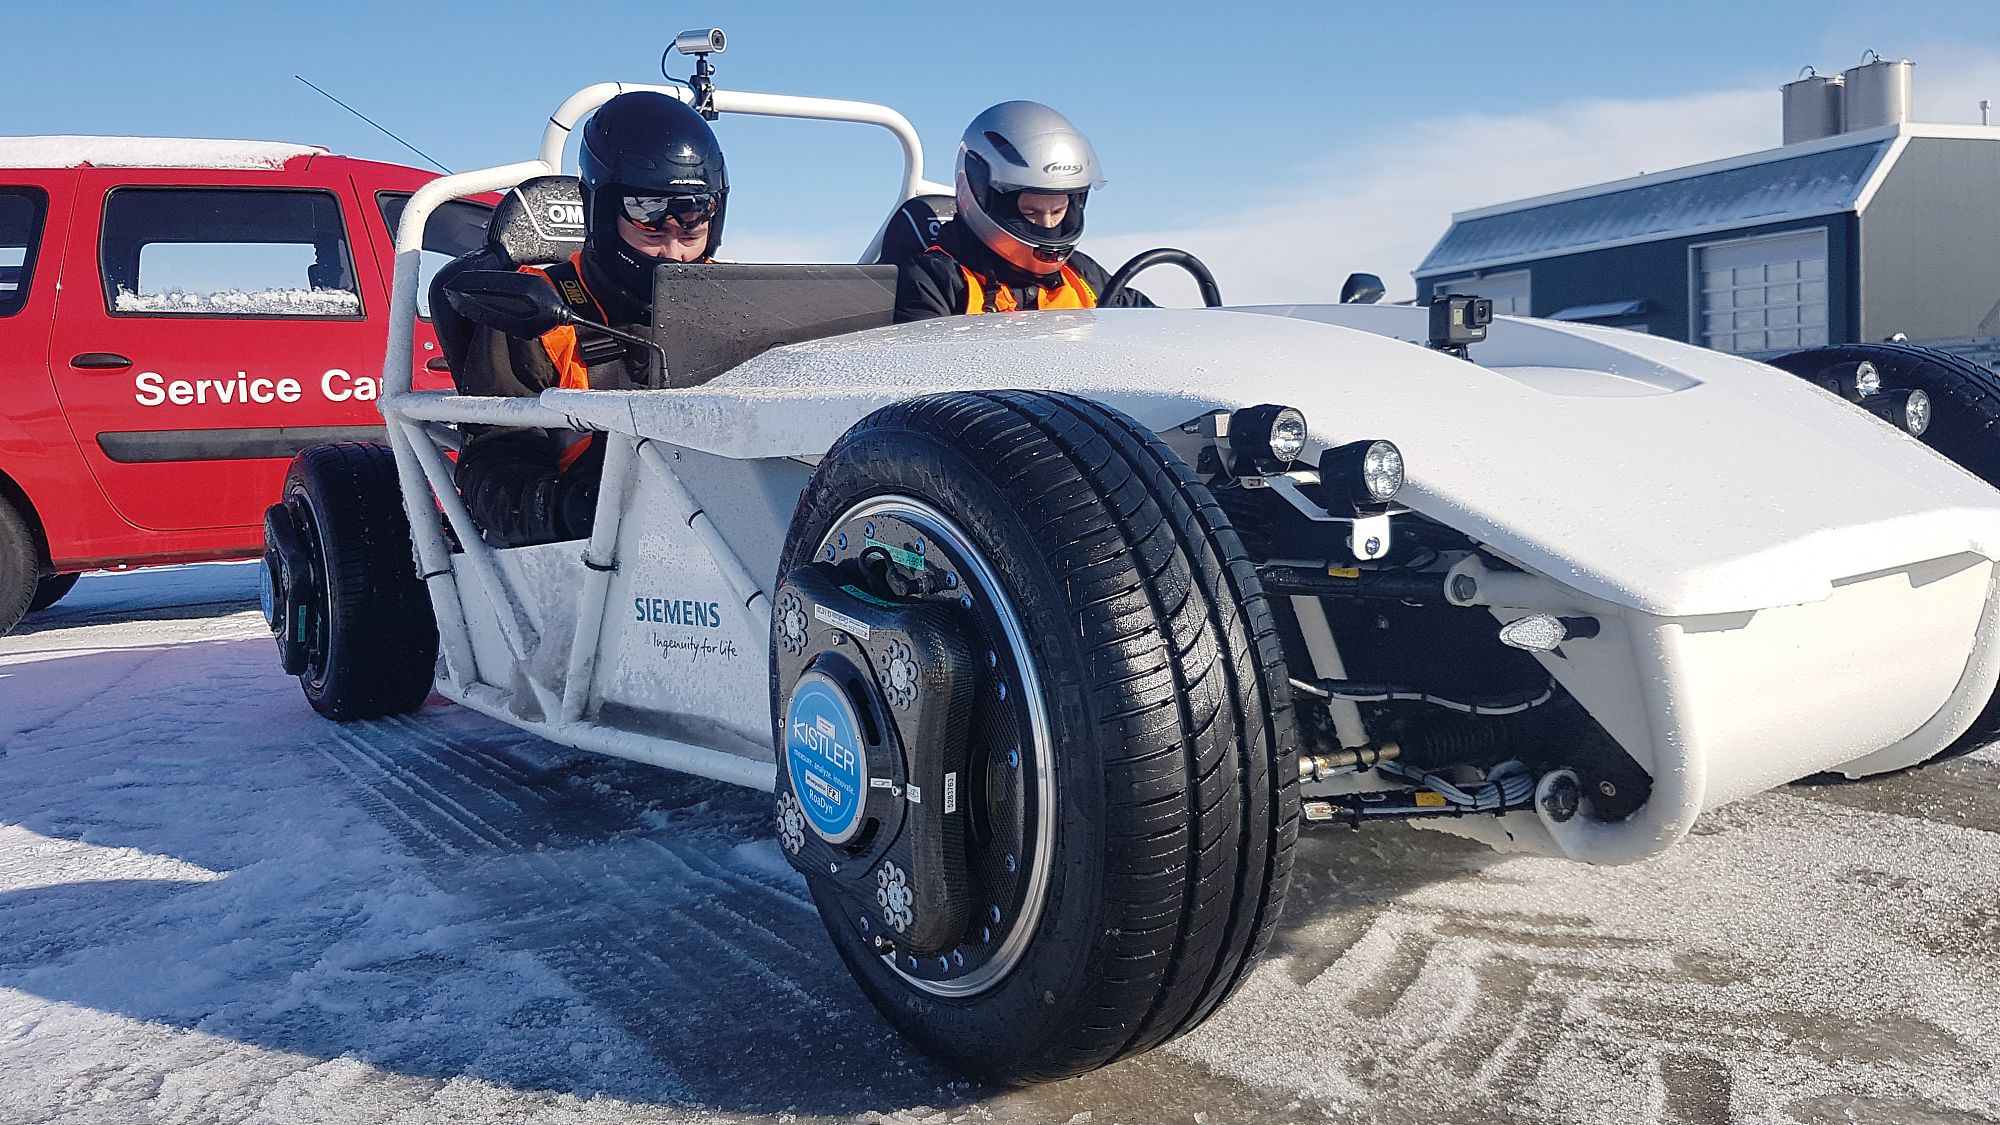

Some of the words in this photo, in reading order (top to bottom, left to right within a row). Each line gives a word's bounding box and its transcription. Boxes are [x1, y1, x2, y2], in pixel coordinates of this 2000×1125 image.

[548, 204, 585, 224] OM
[563, 280, 585, 304] OMP
[134, 371, 302, 407] Service
[321, 368, 384, 402] Ca
[634, 597, 721, 628] SIEMENS
[653, 632, 700, 662] Ingenuity
[700, 637, 717, 657] for
[719, 639, 738, 661] life
[792, 716, 855, 776] KISTLER
[809, 788, 833, 815] RoaDyn
